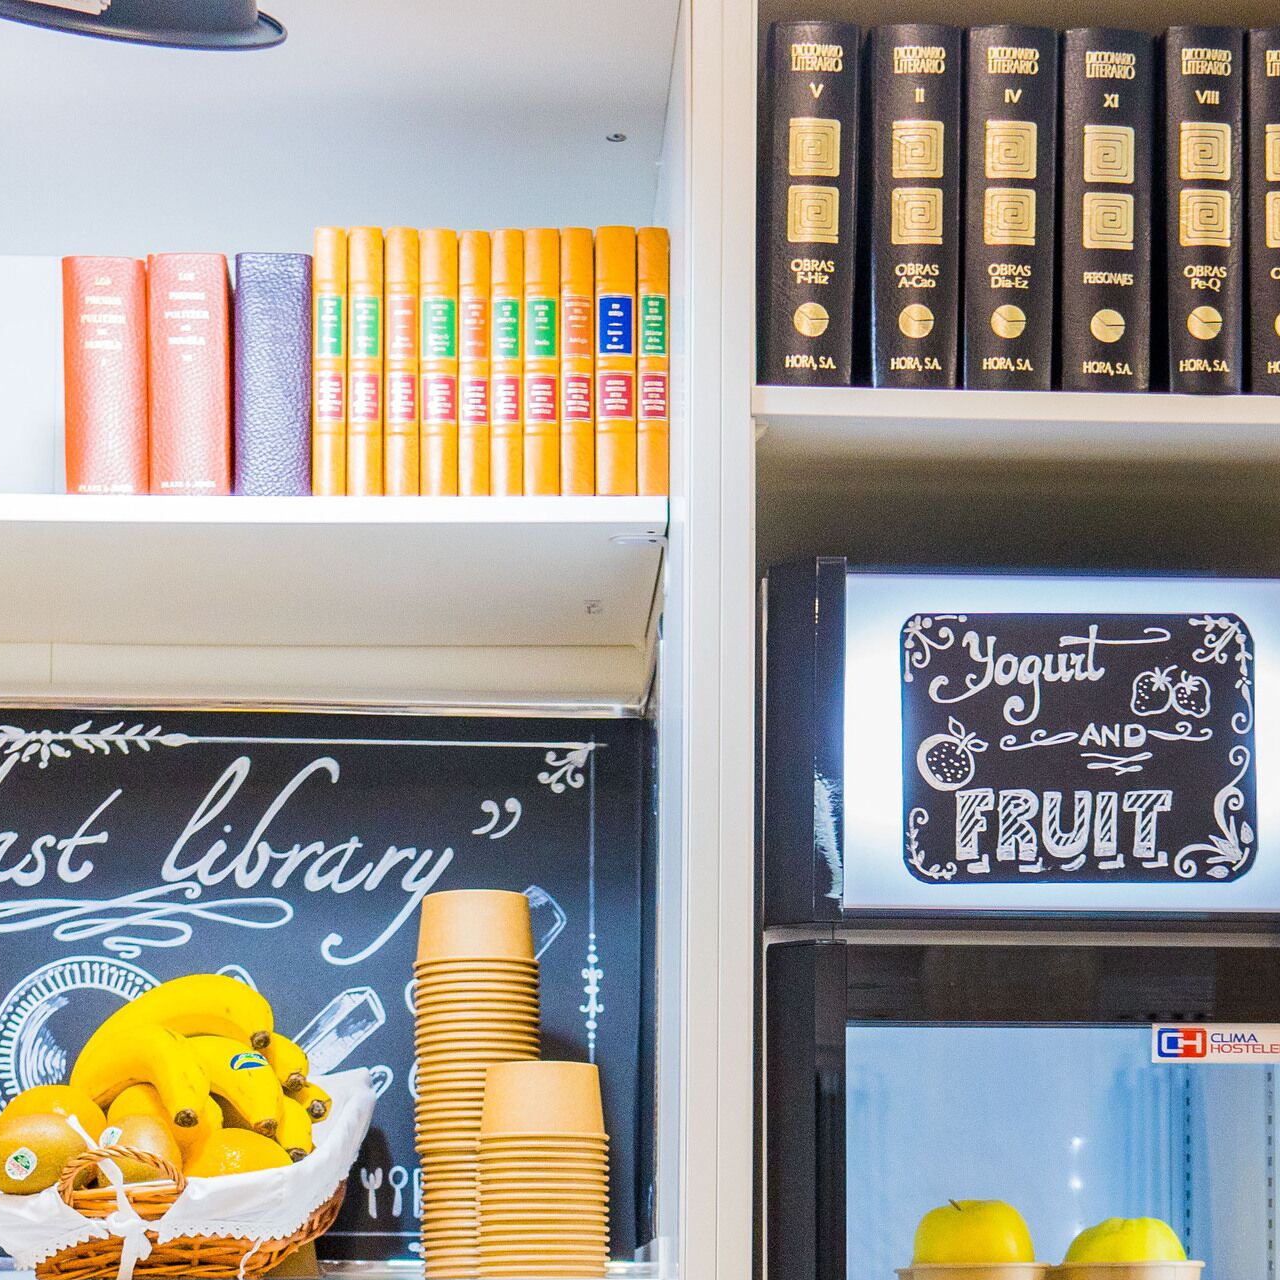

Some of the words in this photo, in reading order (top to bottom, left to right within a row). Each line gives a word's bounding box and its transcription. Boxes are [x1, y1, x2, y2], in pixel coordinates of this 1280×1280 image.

[792, 58, 842, 72] LITERARIO
[895, 59, 945, 74] LITERARIO
[988, 60, 1038, 75] LITERARIO
[1086, 64, 1135, 79] LITERARIO
[1182, 61, 1231, 76] LITERARIO
[809, 83, 824, 98] V
[915, 89, 925, 103] II
[1004, 89, 1021, 103] IV
[1195, 90, 1219, 104] VIII
[1104, 94, 1119, 108] XI
[791, 259, 834, 273] OBRAS
[895, 264, 939, 276] OBRAS
[988, 264, 1031, 277] OBRAS
[1184, 266, 1227, 279] OBRAS
[928, 624, 1172, 726] Yogurt
[1078, 723, 1147, 748] AND
[955, 788, 1173, 874] FRUIT
[1210, 1033, 1258, 1043] CLIMA
